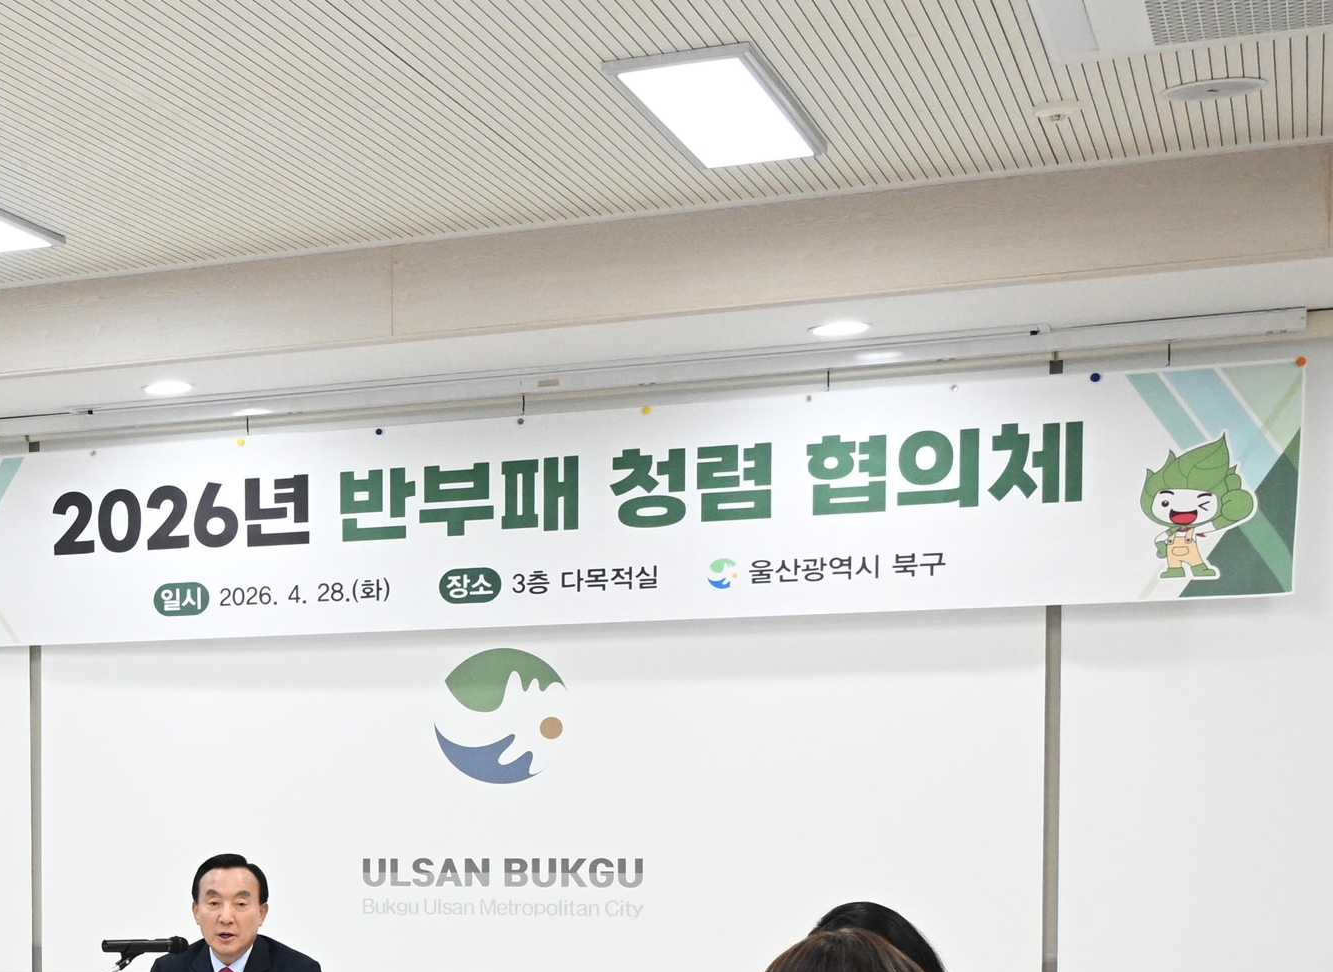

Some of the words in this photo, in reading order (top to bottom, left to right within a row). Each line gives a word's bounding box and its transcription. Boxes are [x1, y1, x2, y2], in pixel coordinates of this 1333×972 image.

[52, 473, 311, 556] 2026년
[339, 455, 580, 543] 반부패
[609, 442, 772, 529] 청렴
[806, 420, 1084, 516] 협의체
[445, 573, 494, 599] 장소
[511, 570, 550, 595] 3층
[560, 564, 659, 592] 다목적실
[748, 553, 881, 583] 울산광역시
[891, 551, 947, 577] 북구
[160, 587, 204, 612] 일시
[219, 587, 278, 607] 2026.
[288, 586, 307, 605] 4.
[316, 577, 391, 604] 28.(화)
[362, 857, 490, 888] ULSAN
[503, 857, 644, 888] BUKGU
[362, 898, 419, 916] Bukgu
[423, 898, 475, 916] Ulsan
[480, 898, 600, 918] Metropolitan
[605, 899, 644, 918] City
